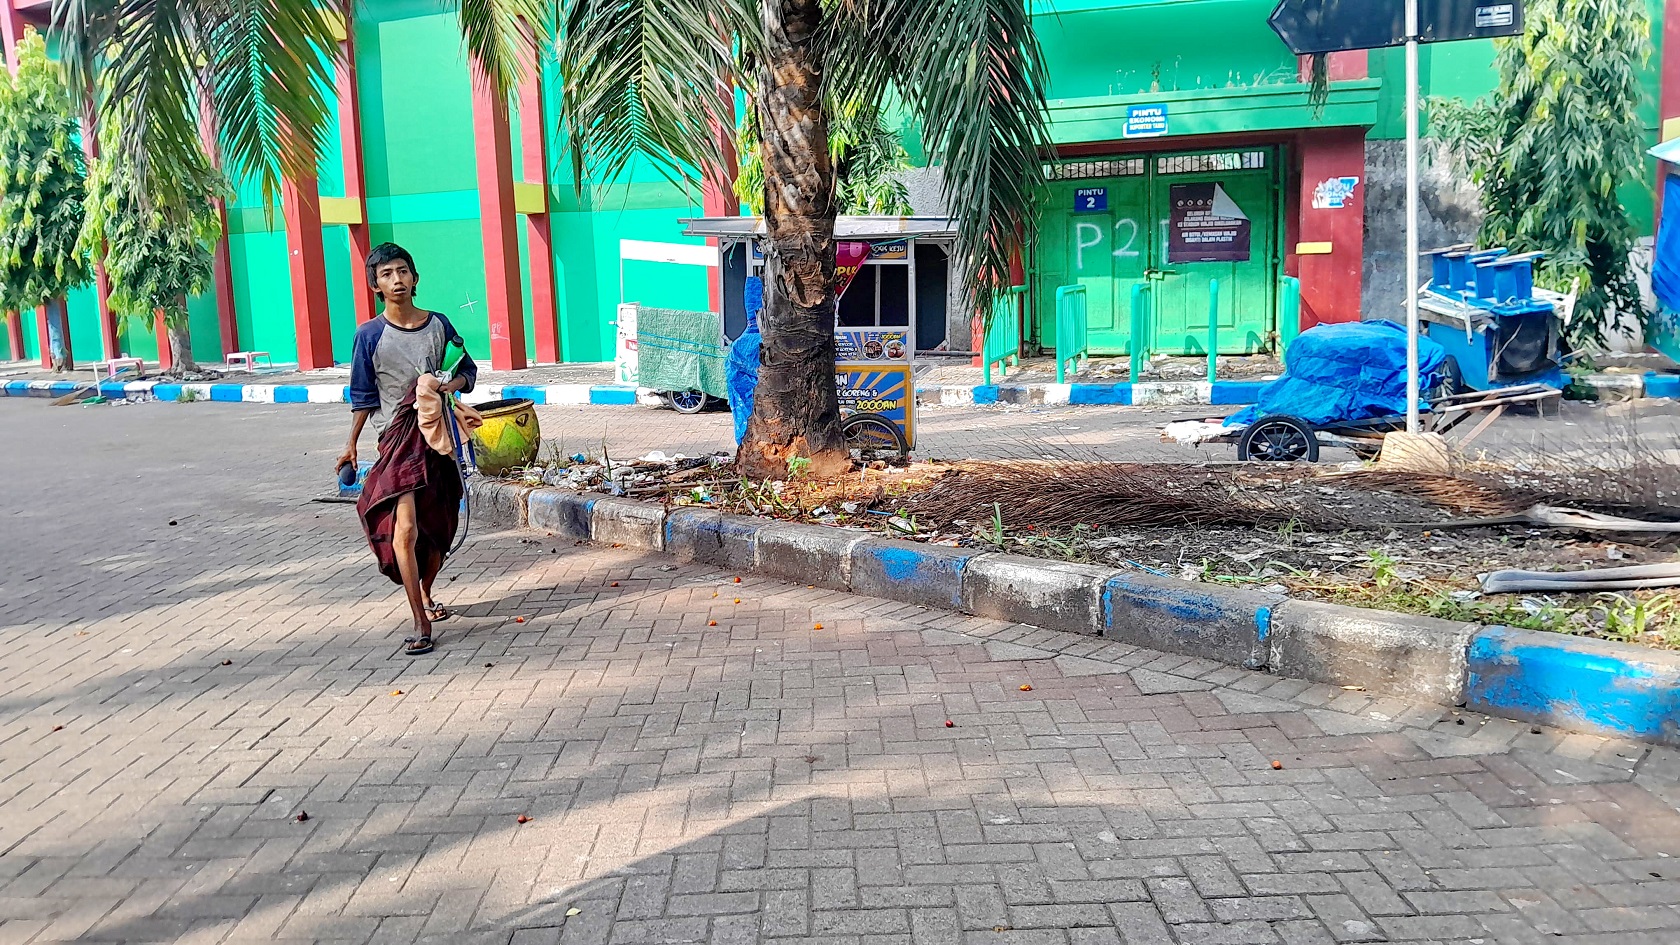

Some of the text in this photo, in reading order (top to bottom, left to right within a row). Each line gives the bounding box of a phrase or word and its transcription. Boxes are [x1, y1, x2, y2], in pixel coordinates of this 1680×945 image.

[1132, 108, 1162, 117] PINTU
[1129, 116, 1165, 124] EKONOMI
[1078, 188, 1104, 196] PINTU
[1086, 197, 1096, 208] 2
[842, 389, 870, 397] GORENG
[872, 389, 878, 397] &
[857, 400, 897, 411] 2000AN
